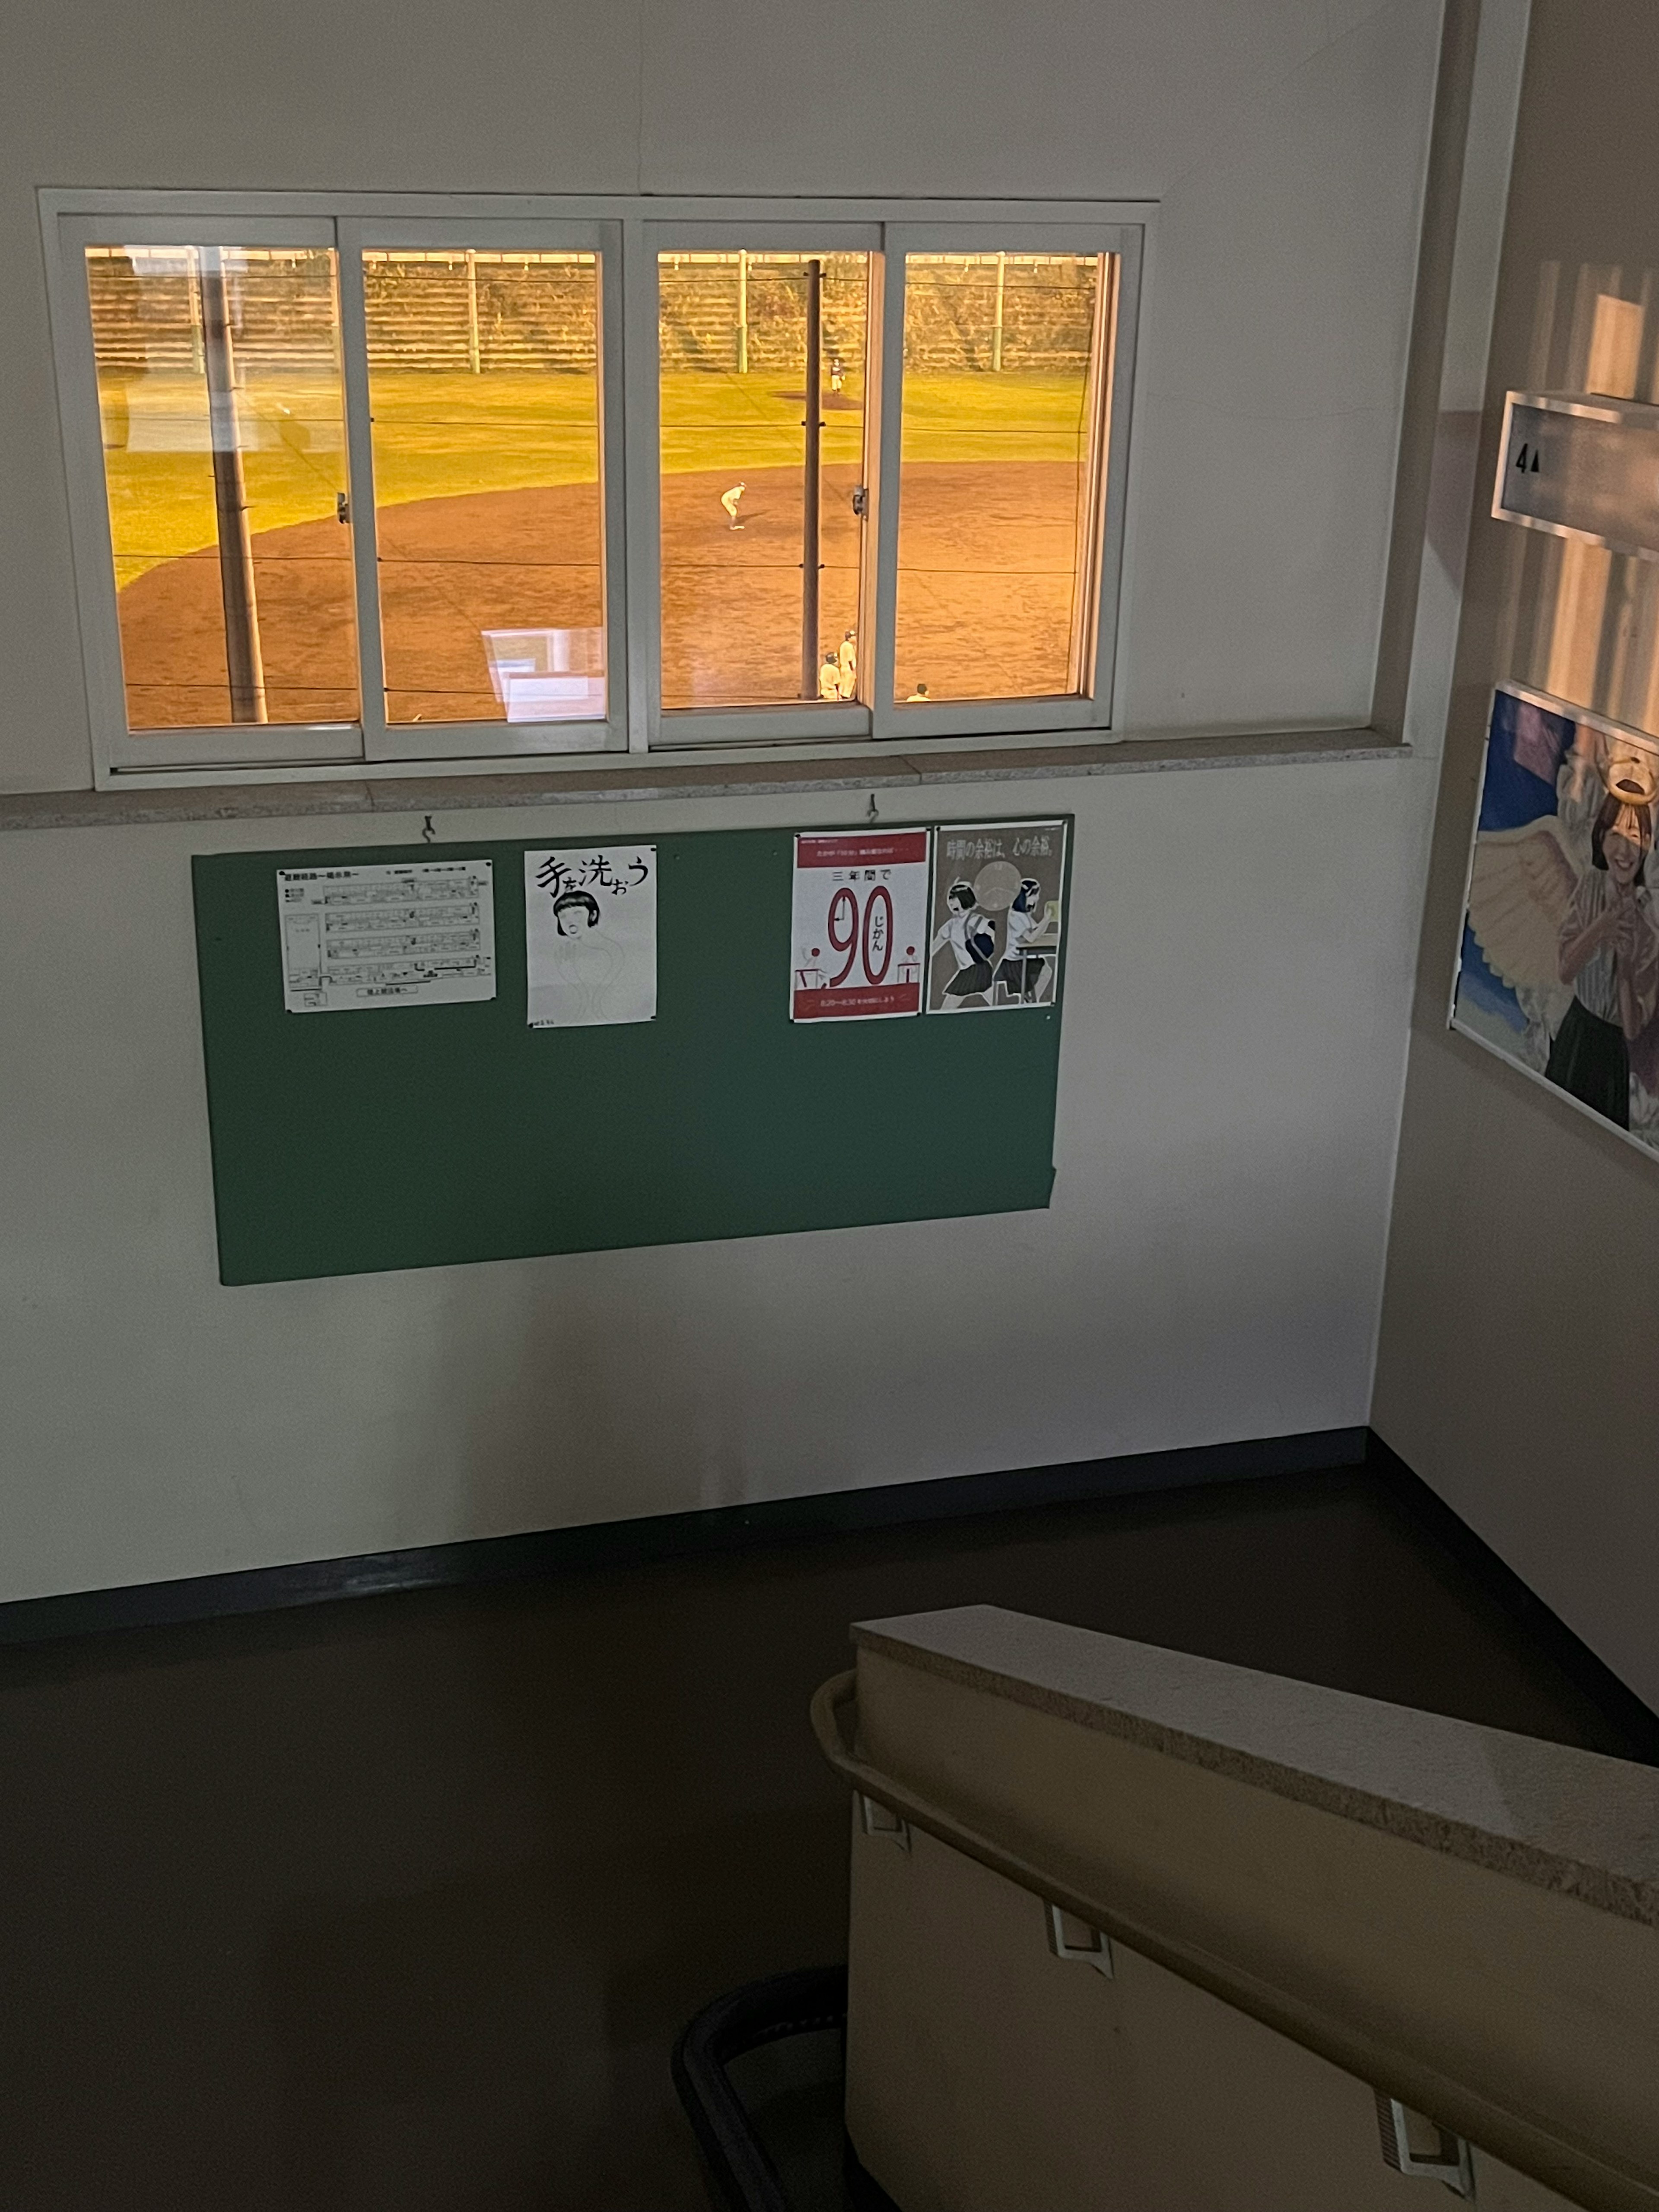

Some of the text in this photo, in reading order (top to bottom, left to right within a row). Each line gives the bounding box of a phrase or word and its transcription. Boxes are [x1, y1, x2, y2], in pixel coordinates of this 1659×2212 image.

[1516, 443, 1528, 474] 4
[832, 869, 891, 882] 三年間で
[828, 885, 893, 988] 90
[871, 915, 885, 952] じかん
